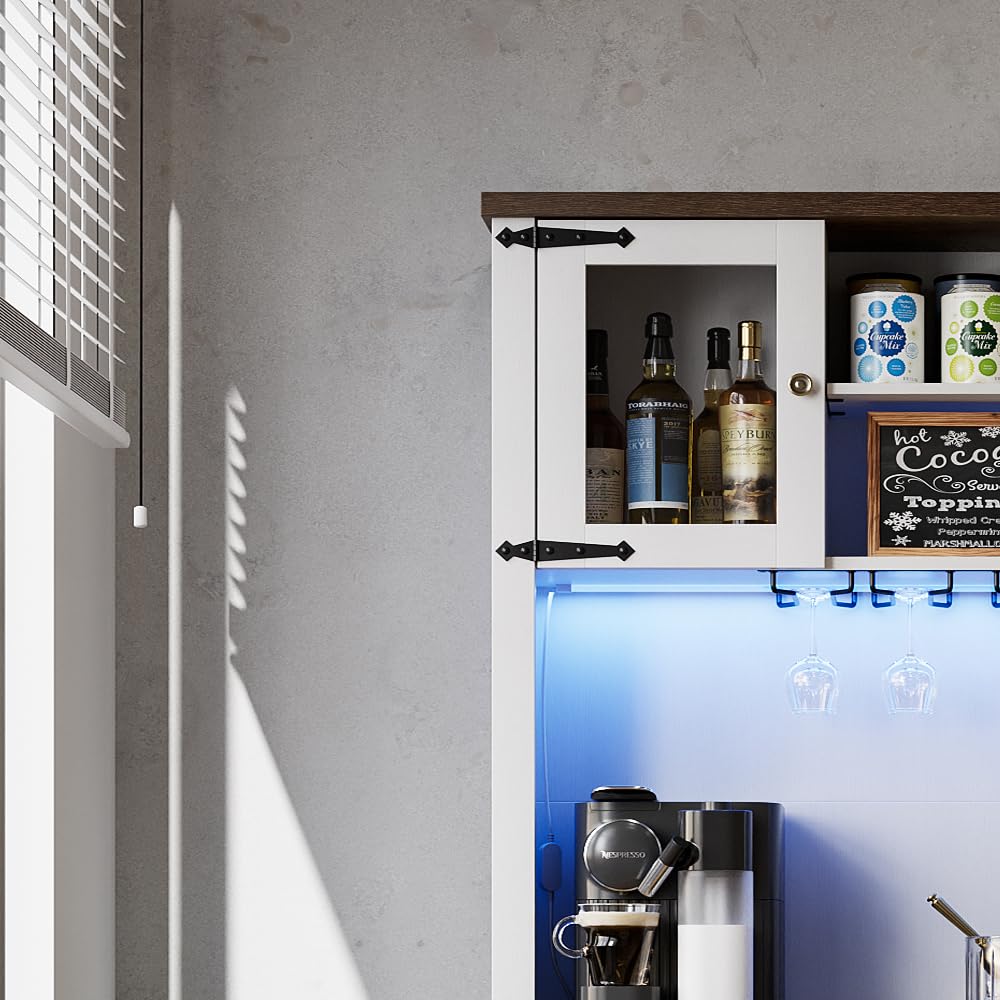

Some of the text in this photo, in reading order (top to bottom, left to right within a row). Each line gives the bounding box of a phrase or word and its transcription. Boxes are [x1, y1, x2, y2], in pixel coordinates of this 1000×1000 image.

[870, 332, 904, 342] Cupcake
[961, 332, 996, 342] Cupcake
[882, 341, 901, 350] Mix
[973, 341, 993, 350] Mix
[627, 401, 689, 410] TORABHAIG
[894, 428, 932, 446] hot
[925, 516, 978, 525] Whipped
[600, 850, 646, 860] NESPRESSO
